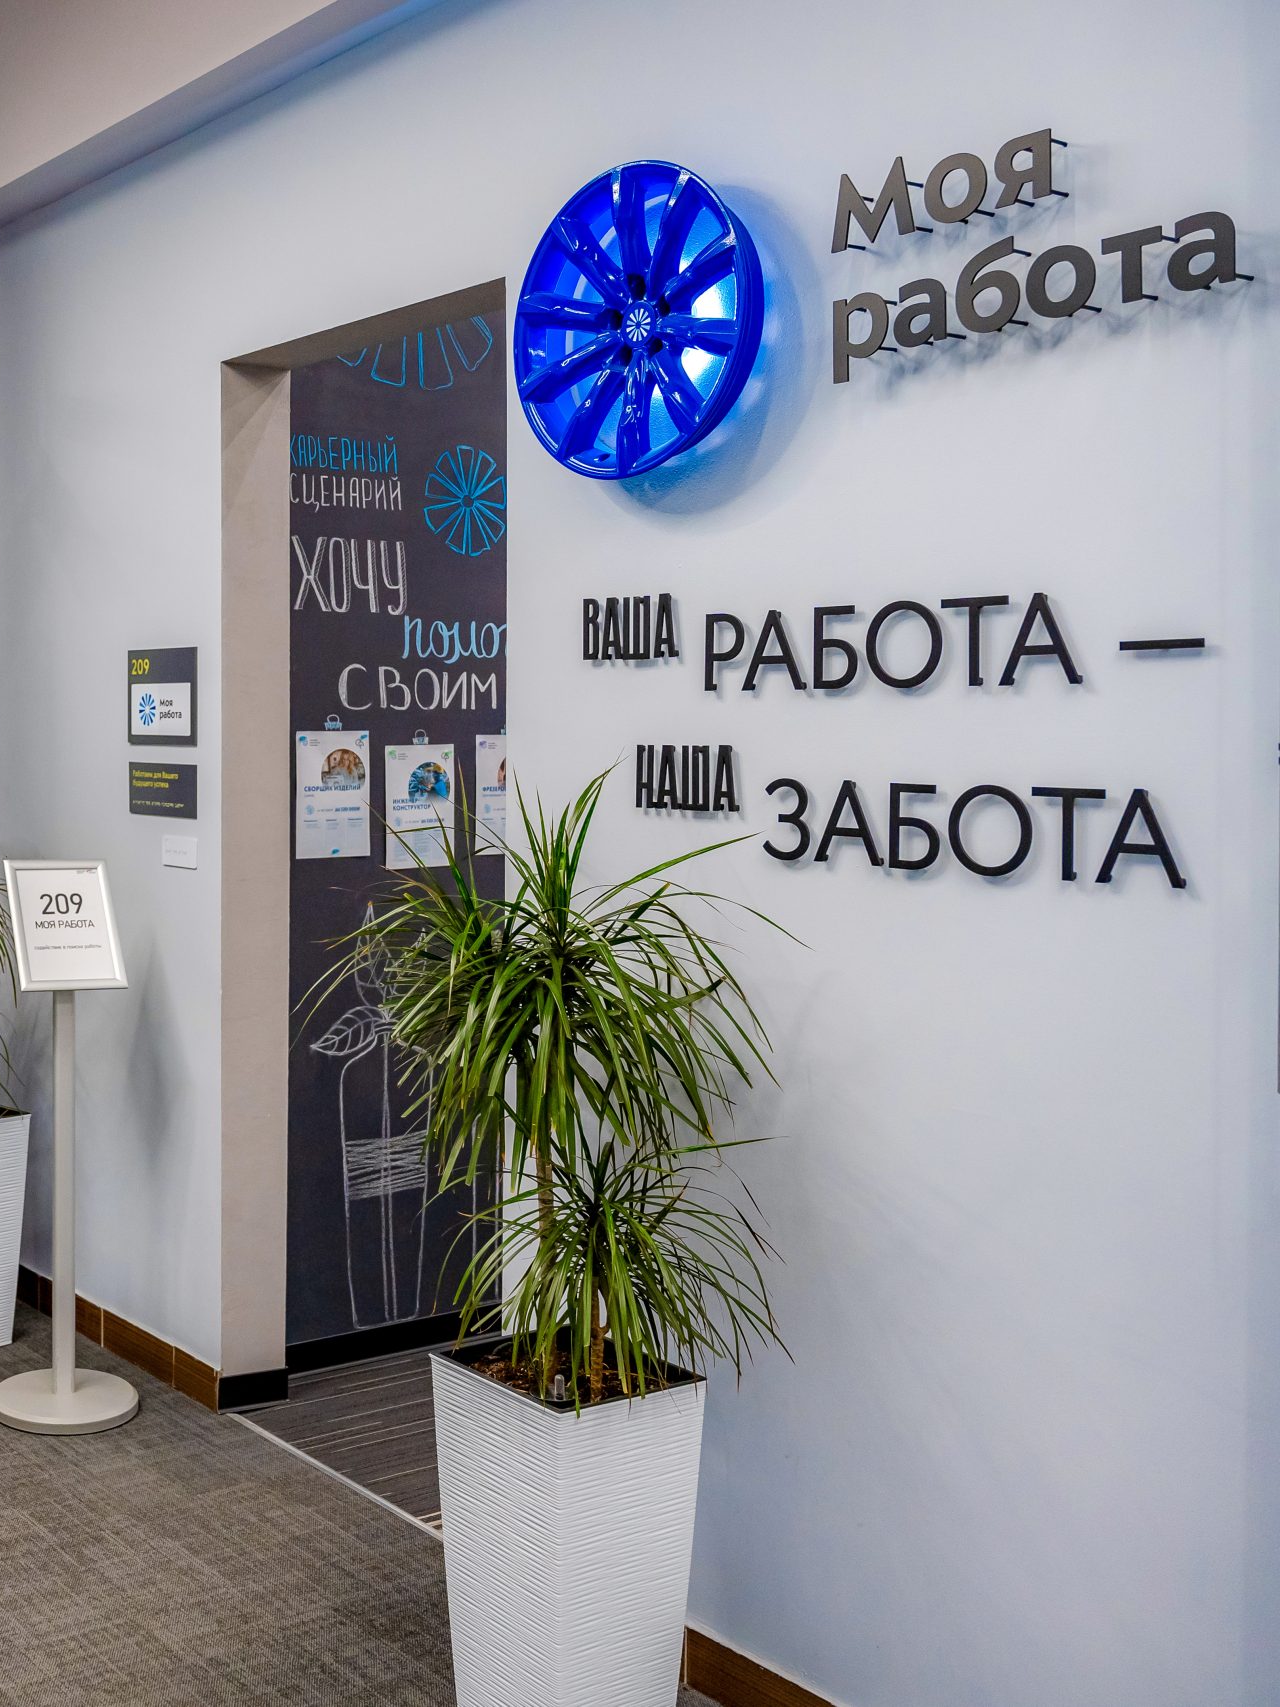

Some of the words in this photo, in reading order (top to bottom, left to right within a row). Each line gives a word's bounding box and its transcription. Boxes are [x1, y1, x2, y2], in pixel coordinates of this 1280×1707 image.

[831, 128, 1053, 254] Моя
[833, 211, 1237, 386] работа
[289, 472, 402, 513] СЦЕНАРИЙ
[291, 534, 408, 616] ХОЧУ
[401, 615, 507, 665] помо
[582, 592, 680, 661] ВАША
[704, 592, 1084, 692] РАБОТА
[131, 658, 150, 675] 209
[338, 663, 498, 711] СВОИМ
[159, 699, 173, 707] Моя
[159, 710, 183, 720] работа
[334, 784, 361, 792] ИЗДЕЛИЙ
[635, 744, 740, 812] НАША
[762, 777, 1187, 889] ЗАБОТА
[35, 920, 56, 929] МОЯ
[58, 919, 95, 929] РАБОТА
[39, 893, 83, 915] 209
